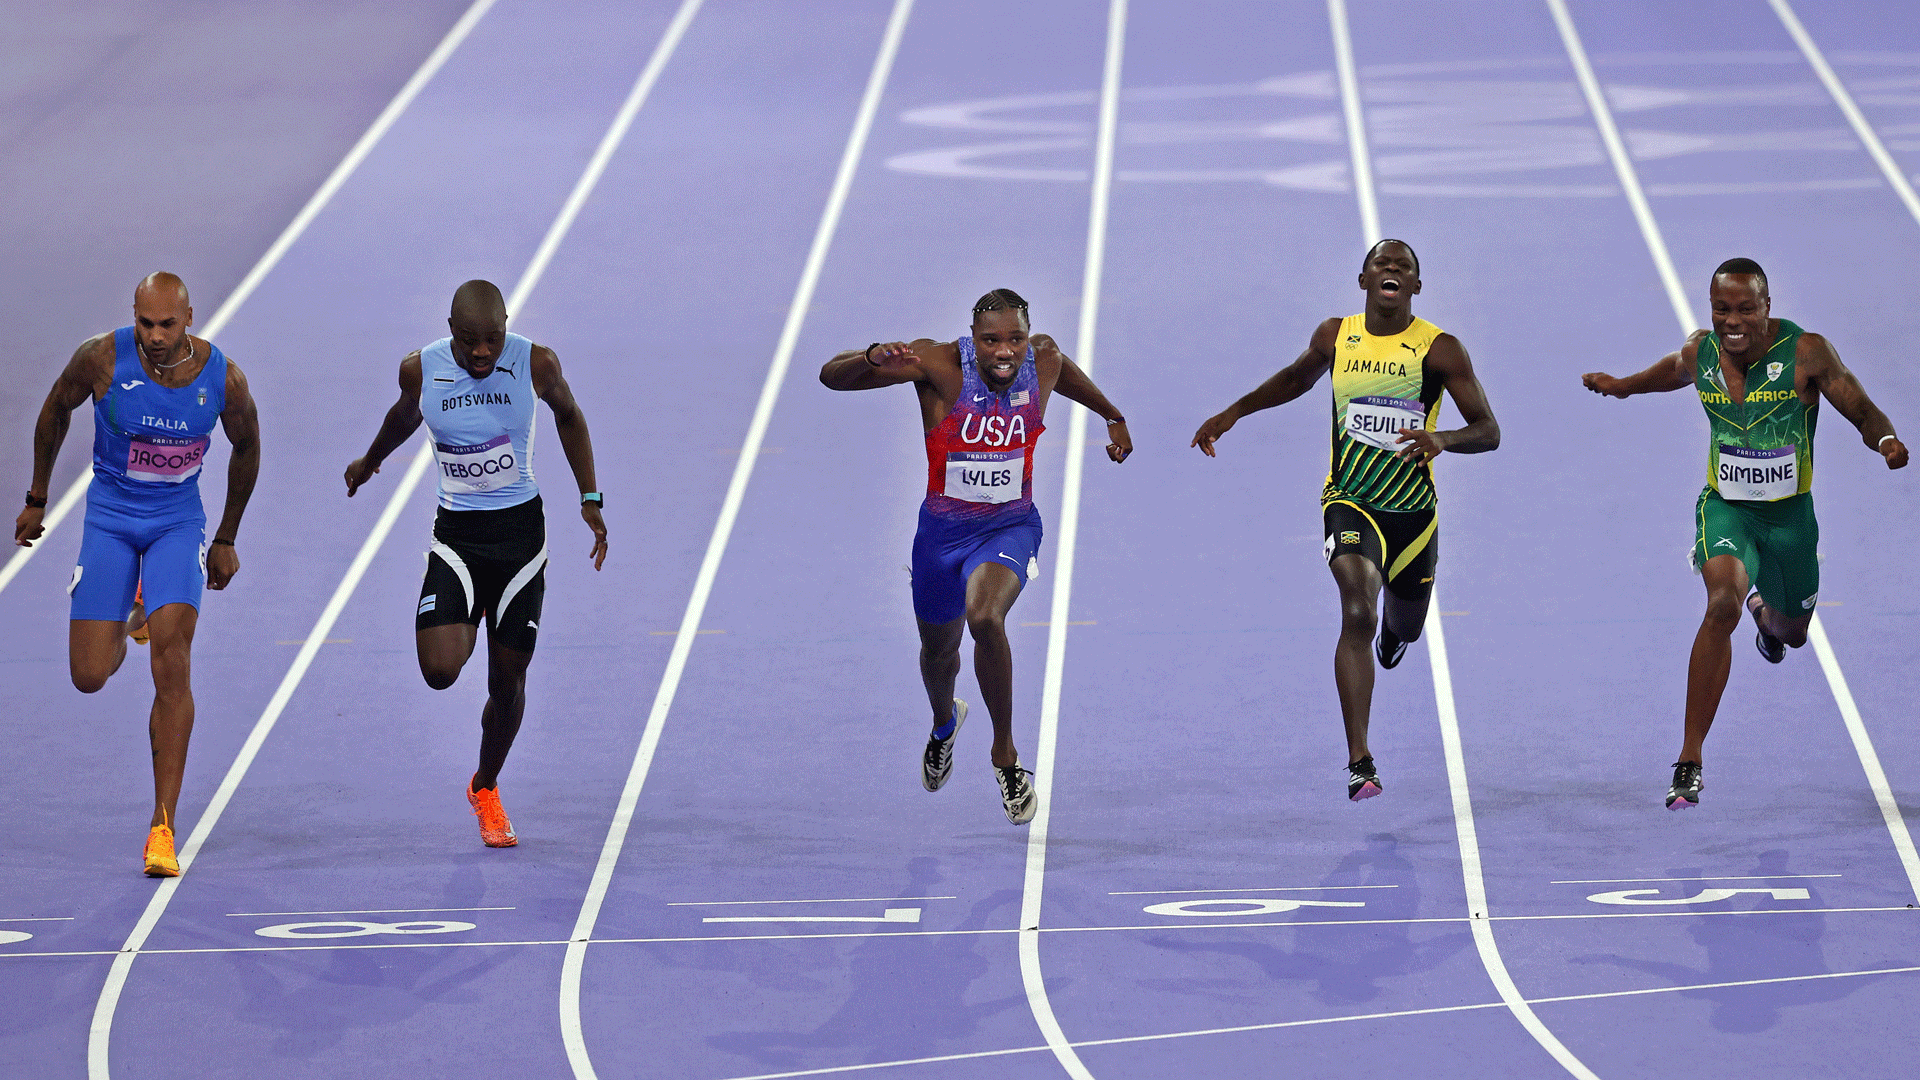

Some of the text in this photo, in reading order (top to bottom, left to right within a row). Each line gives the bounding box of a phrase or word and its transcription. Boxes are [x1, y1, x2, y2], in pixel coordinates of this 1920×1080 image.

[1344, 359, 1407, 377] JAMAICA
[442, 393, 512, 412] BOTSWANA
[1745, 389, 1798, 403] AFRICA
[142, 415, 189, 431] ITALIA
[961, 413, 1026, 447] USA
[131, 447, 201, 469] JACOBS
[1736, 449, 1756, 457] PARIS
[441, 454, 514, 478] TEBOGO
[1719, 463, 1794, 484] SIMBINE
[962, 469, 1011, 487] LYLES
[1586, 887, 1811, 905] 5
[702, 907, 922, 923] 7
[1142, 898, 1366, 917] 6
[254, 921, 477, 939] 8
